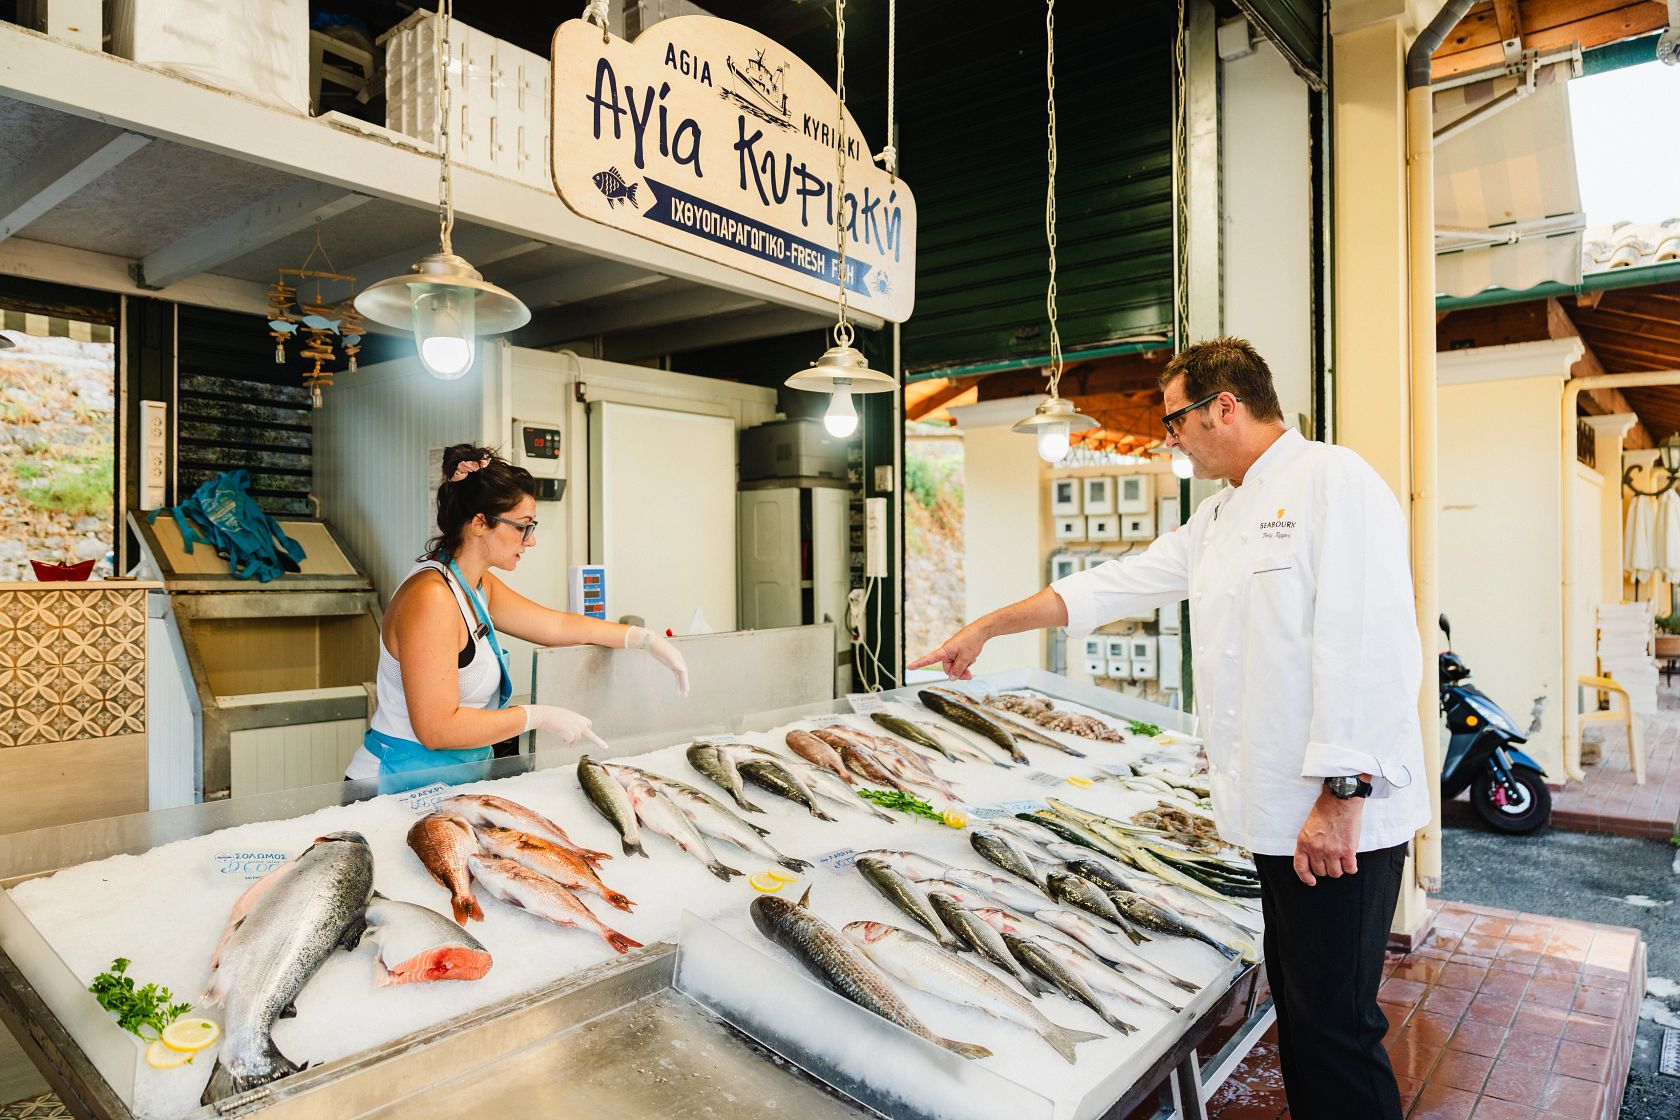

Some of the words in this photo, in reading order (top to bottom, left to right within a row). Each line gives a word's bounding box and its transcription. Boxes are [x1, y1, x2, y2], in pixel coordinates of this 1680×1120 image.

[664, 42, 713, 88] AGIA
[803, 113, 860, 161] KYRIAKI
[586, 58, 703, 178] Αγία
[831, 257, 854, 285] FH
[1259, 520, 1296, 530] SEABOURN
[235, 852, 288, 860] ΣΟΛΩΜΟΣ
